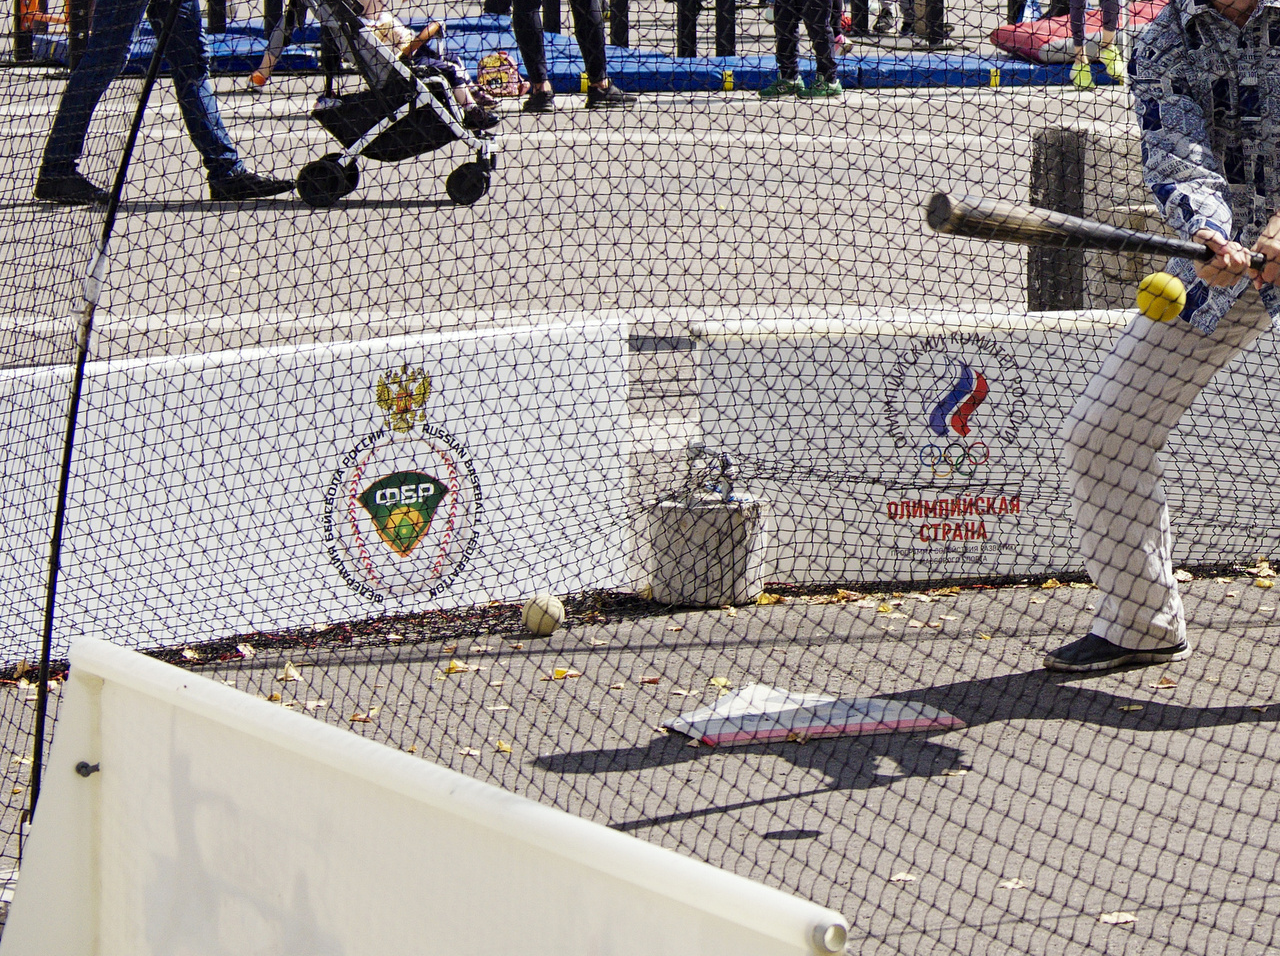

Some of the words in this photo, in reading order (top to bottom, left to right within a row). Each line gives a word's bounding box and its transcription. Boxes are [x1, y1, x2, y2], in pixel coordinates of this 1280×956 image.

[950, 332, 1019, 372] КОМИТЕТ
[1001, 375, 1026, 445] РОССИИ
[342, 429, 385, 468] РОССИИ
[422, 424, 467, 459] RUSSIAN
[323, 468, 346, 542] БЕЙСБОЛА
[375, 483, 435, 506] ФБР
[463, 459, 483, 526] BASEBALL
[887, 493, 1021, 520] ОЛИМПИЙСКАЯ
[919, 521, 988, 543] СТРАНА
[327, 546, 385, 604] ФЕДЕРАЦИЯ
[429, 531, 480, 598] FEDERATION
